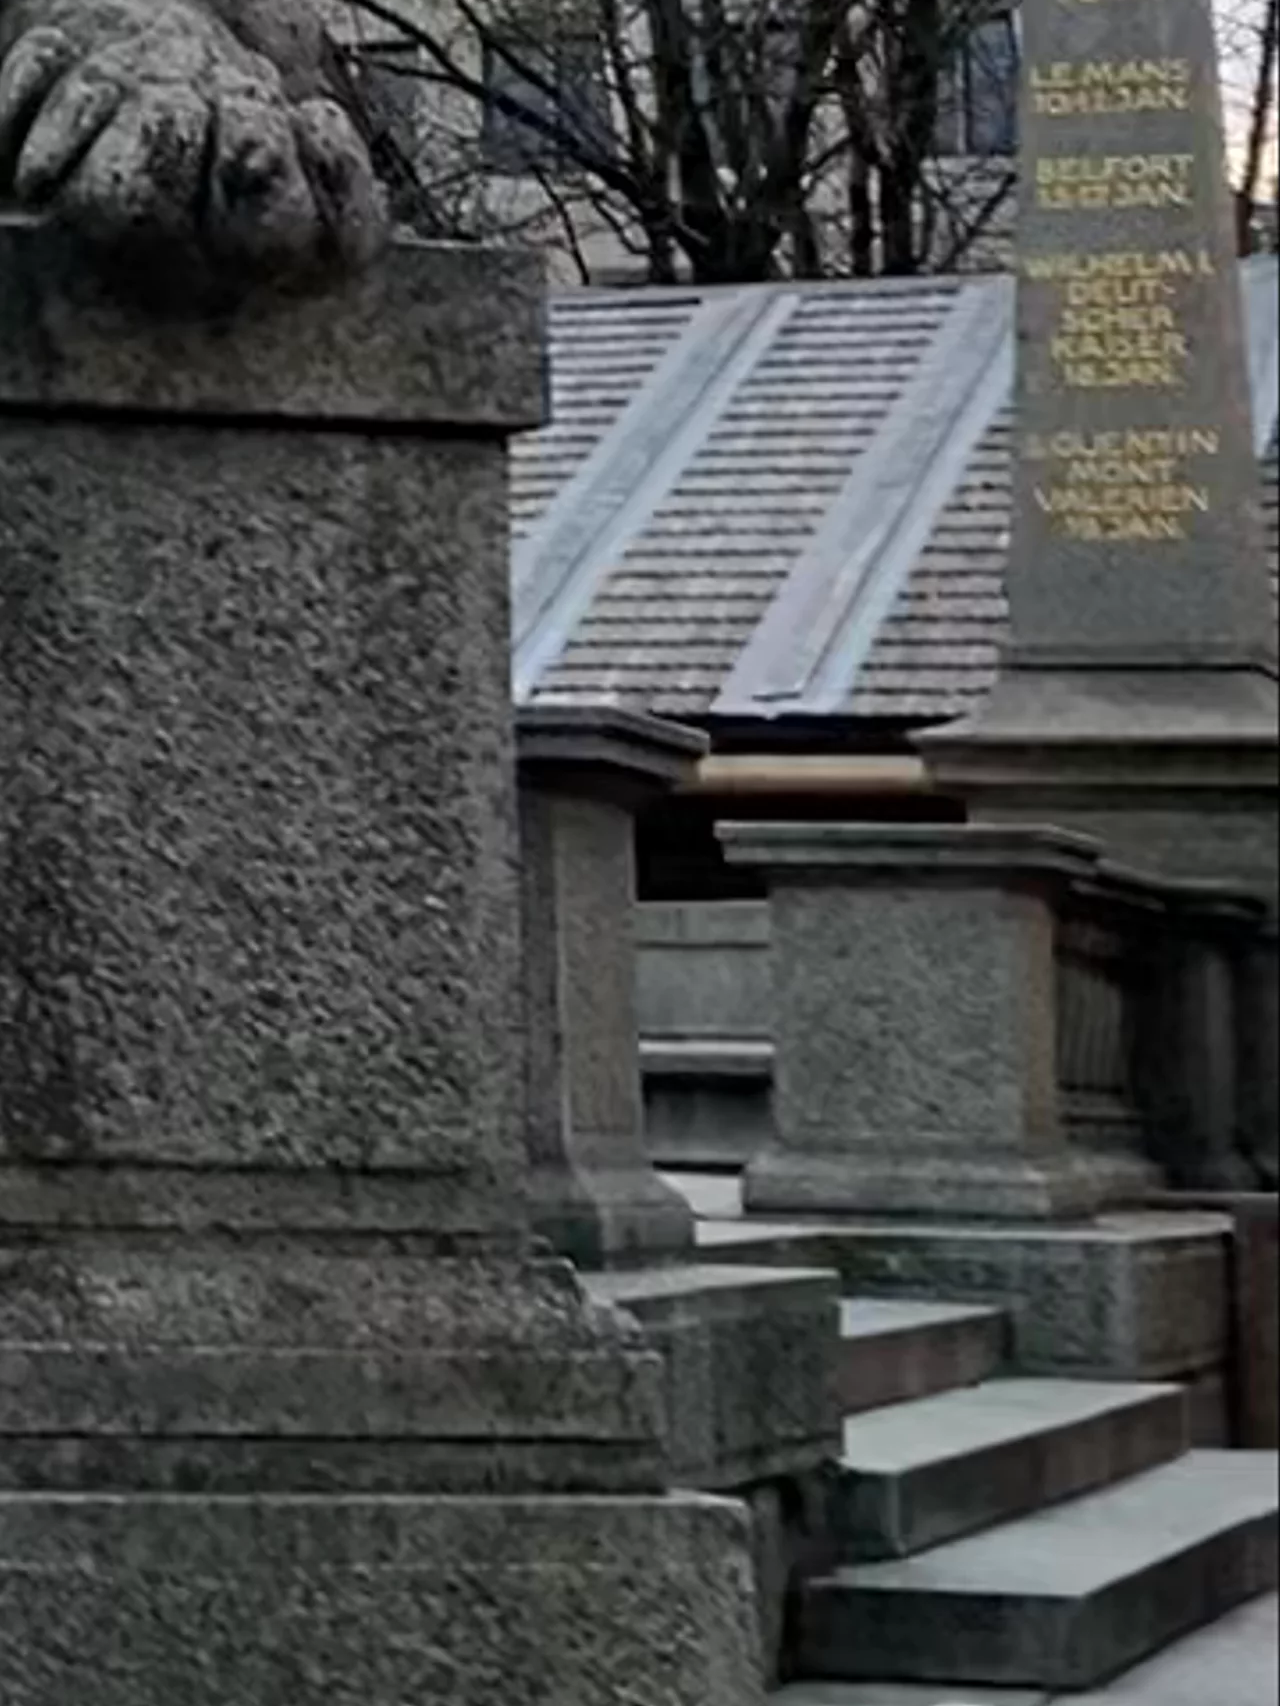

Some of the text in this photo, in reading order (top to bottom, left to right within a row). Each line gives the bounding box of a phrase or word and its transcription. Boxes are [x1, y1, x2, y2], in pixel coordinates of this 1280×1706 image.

[1029, 59, 1189, 87] LE MANS
[1037, 154, 1194, 184] BELFORT
[1023, 251, 1192, 279] WILHELM
[1060, 305, 1174, 333] SCHER
[1051, 332, 1189, 360] KAISER
[1067, 458, 1177, 483] MONT
